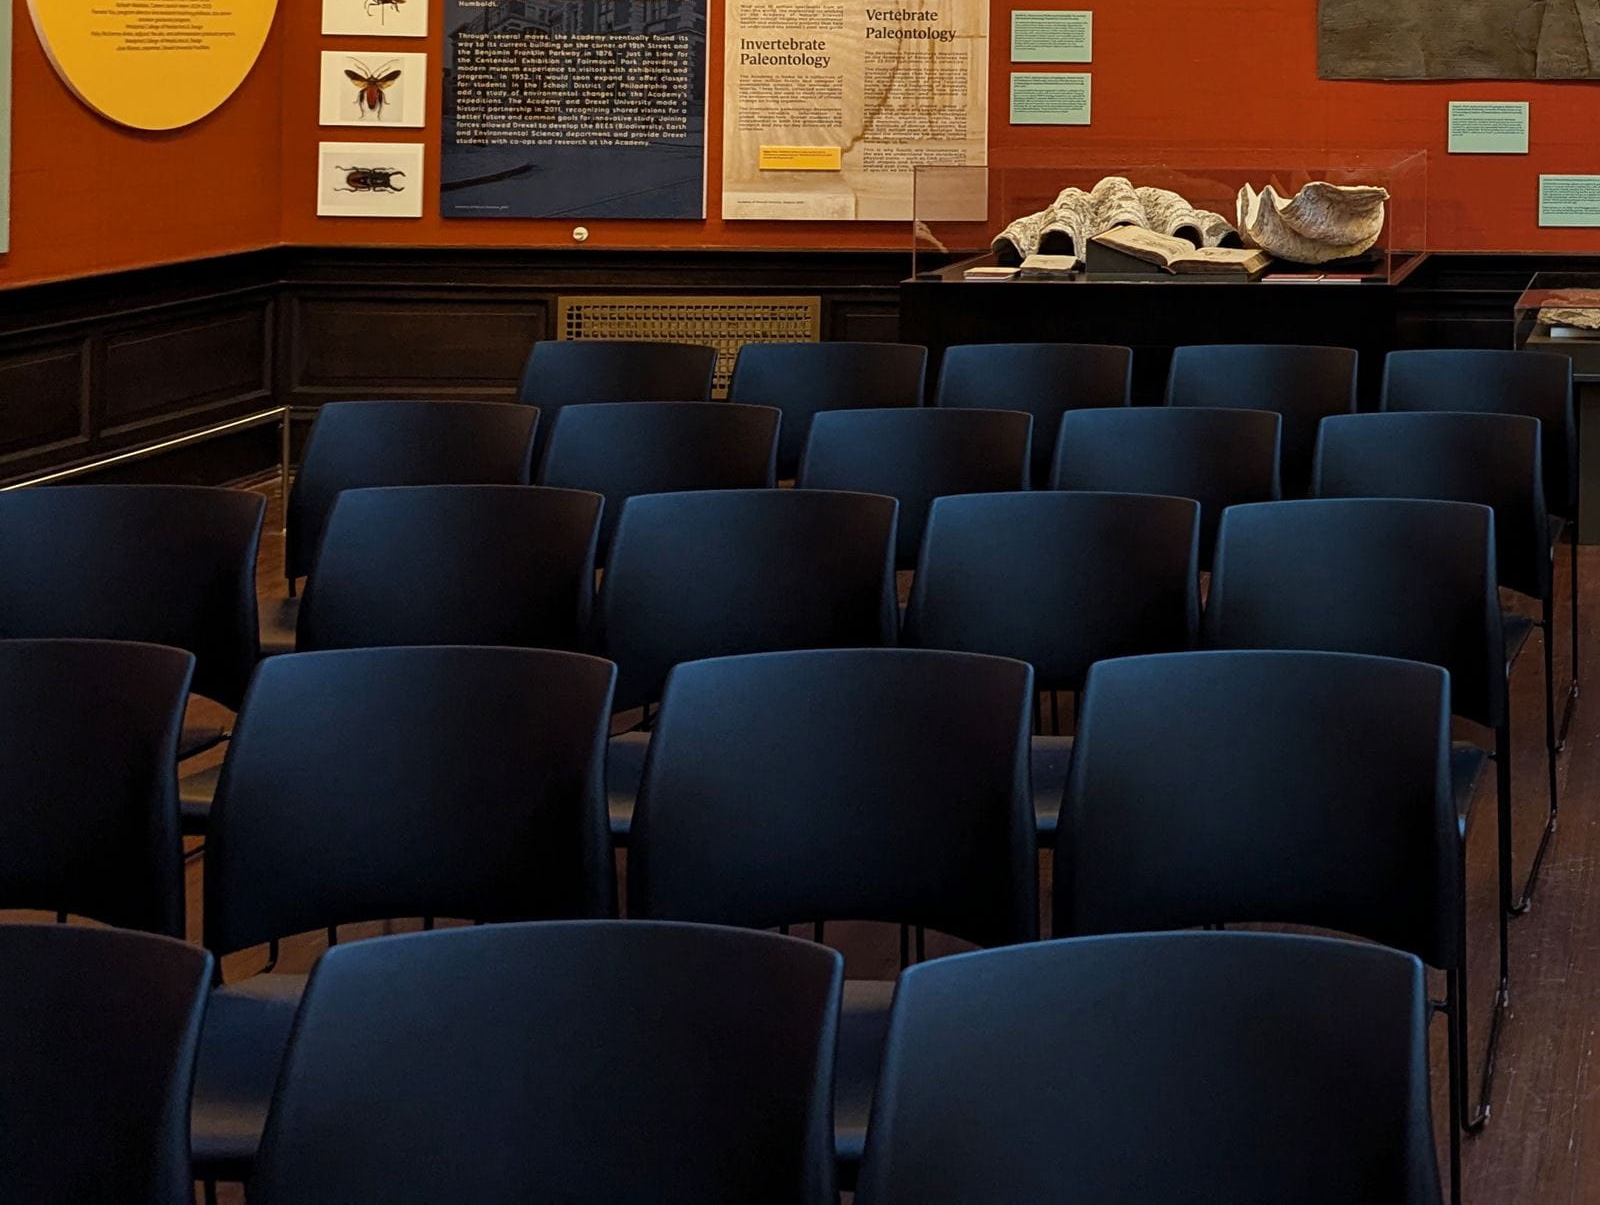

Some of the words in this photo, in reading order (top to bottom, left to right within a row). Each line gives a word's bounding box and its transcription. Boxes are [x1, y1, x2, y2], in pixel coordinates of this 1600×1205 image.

[866, 8, 938, 22] Vertebrate
[866, 26, 956, 42] Paleontology
[742, 38, 826, 52] Invertebrate
[740, 52, 830, 68] Paleontology
